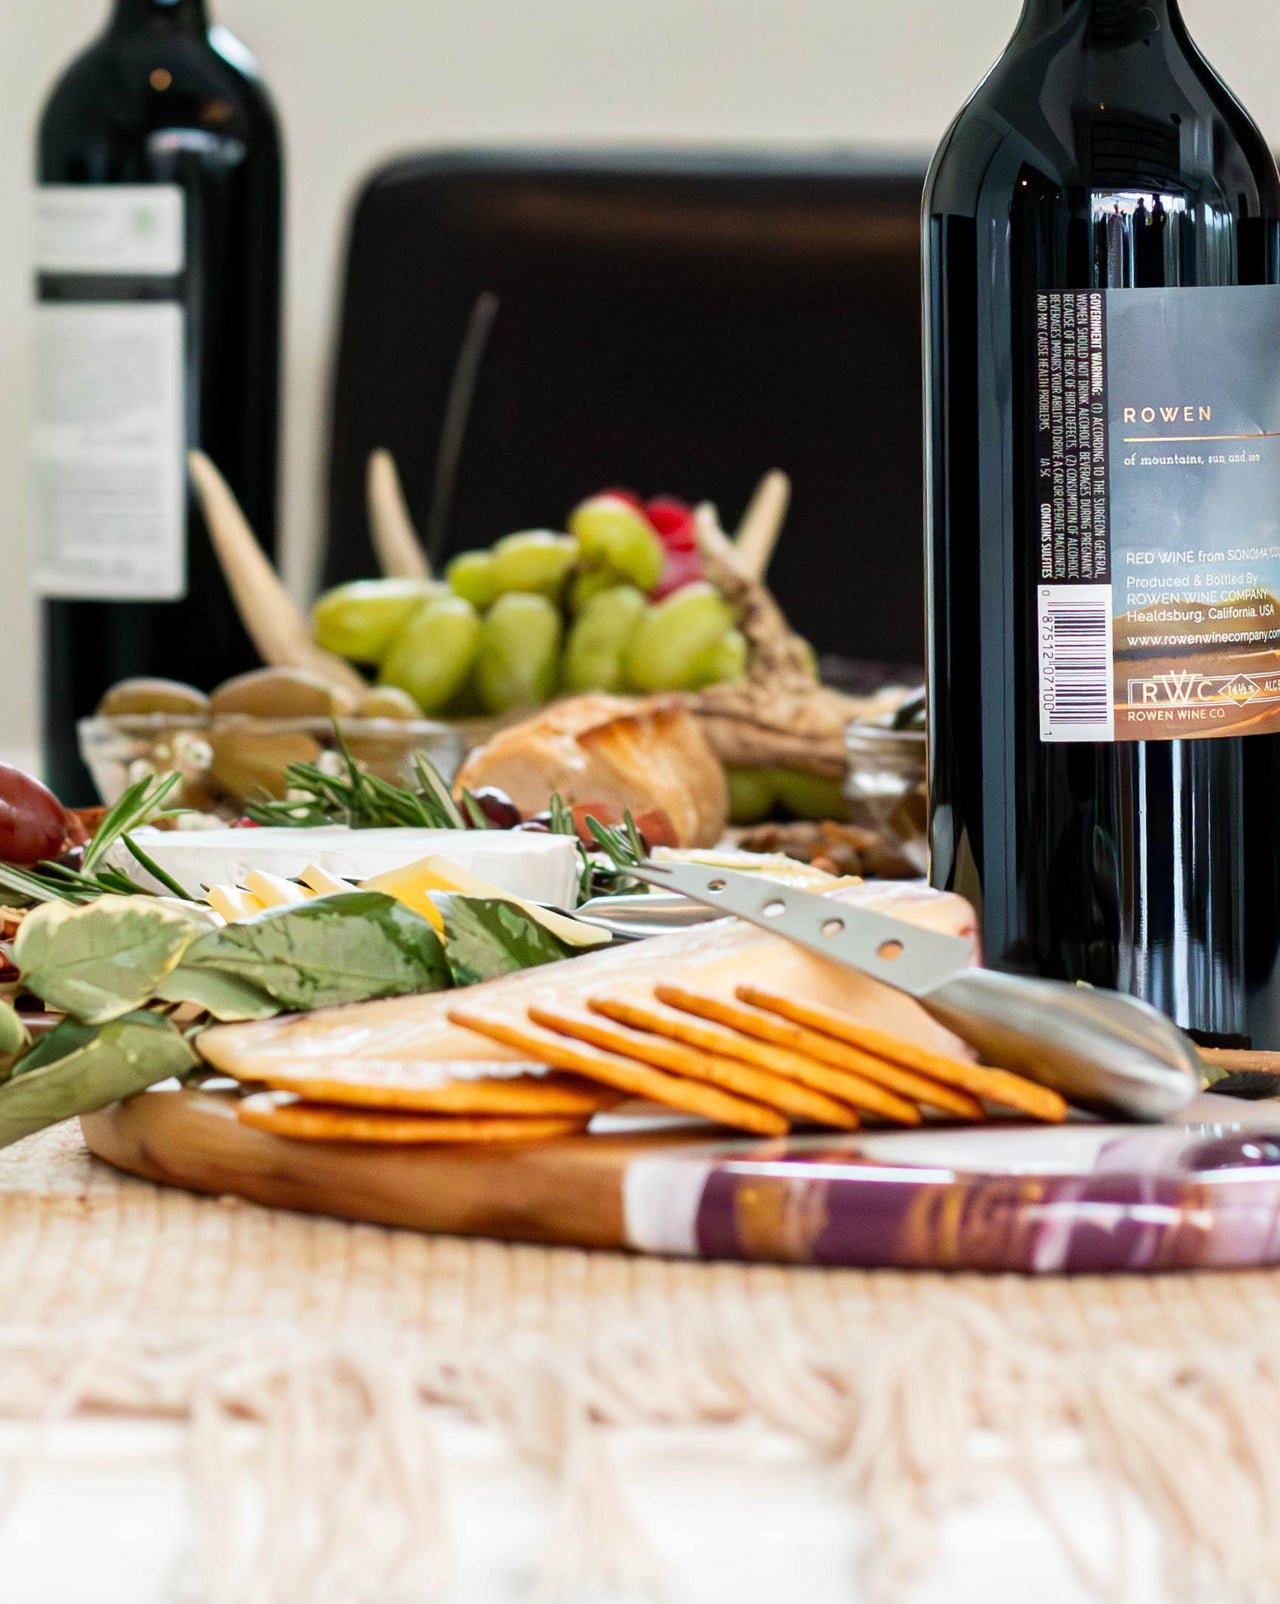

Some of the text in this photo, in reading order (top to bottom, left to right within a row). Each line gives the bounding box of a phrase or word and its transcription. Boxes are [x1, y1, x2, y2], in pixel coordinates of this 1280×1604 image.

[1037, 294, 1048, 311] AND
[1063, 293, 1074, 328] BECAUSE
[1037, 313, 1048, 330] MAY
[1050, 294, 1061, 338] BEVERAGES
[1090, 293, 1102, 349] GOVERNMENT
[1038, 332, 1048, 356] CAUSE
[1064, 330, 1075, 340] OF
[1051, 340, 1061, 371] IMPAIRS
[1064, 343, 1075, 356] THE
[1038, 358, 1049, 387] HEALTH
[1064, 359, 1075, 377] RISK
[1091, 352, 1103, 396] WARNING:
[1051, 372, 1062, 393] YOUR
[1065, 379, 1075, 389] OF
[1052, 395, 1062, 424] ABILITY
[1065, 392, 1076, 414] BIRTH
[1123, 405, 1211, 423] ROWEN
[1076, 293, 1092, 579] WOMEN SHOULD NOT DRINK ALCOHOLIC BEVERAGES DURING PREGNANCY
[1092, 417, 1105, 462] ACCORDING
[1052, 436, 1063, 459] DRIVE
[1124, 452, 1136, 466] of
[1140, 453, 1204, 466] mountains,
[1208, 454, 1226, 464] sun
[1228, 450, 1246, 463] and
[1065, 455, 1077, 466] (2)
[1093, 466, 1105, 476] TO
[1053, 468, 1063, 483] CAR
[1053, 486, 1064, 496] OR
[1066, 468, 1078, 523] CONSUMPTION
[1094, 480, 1105, 495] THE
[1041, 503, 1051, 541] CONTAINS
[1054, 498, 1064, 531] OPERATE
[1094, 498, 1106, 536] SURGEON
[1067, 526, 1078, 535] OF
[1041, 544, 1052, 578] SULFITES
[1067, 538, 1079, 579] ALCOHOLIC
[1094, 540, 1106, 579] GENERAL,
[1126, 552, 1155, 565] RED
[1158, 550, 1195, 563] WINE
[1198, 549, 1225, 562] from
[1126, 572, 1258, 588] Produced & Bottled By
[1126, 588, 1269, 605] ROWEN WINE COMPANY
[1259, 604, 1274, 617] USA
[1042, 615, 1054, 659] 87512
[1042, 666, 1055, 711] 07100
[1142, 669, 1214, 704] RWC
[1128, 710, 1174, 722] ROWEN
[1177, 709, 1206, 720] WINE
